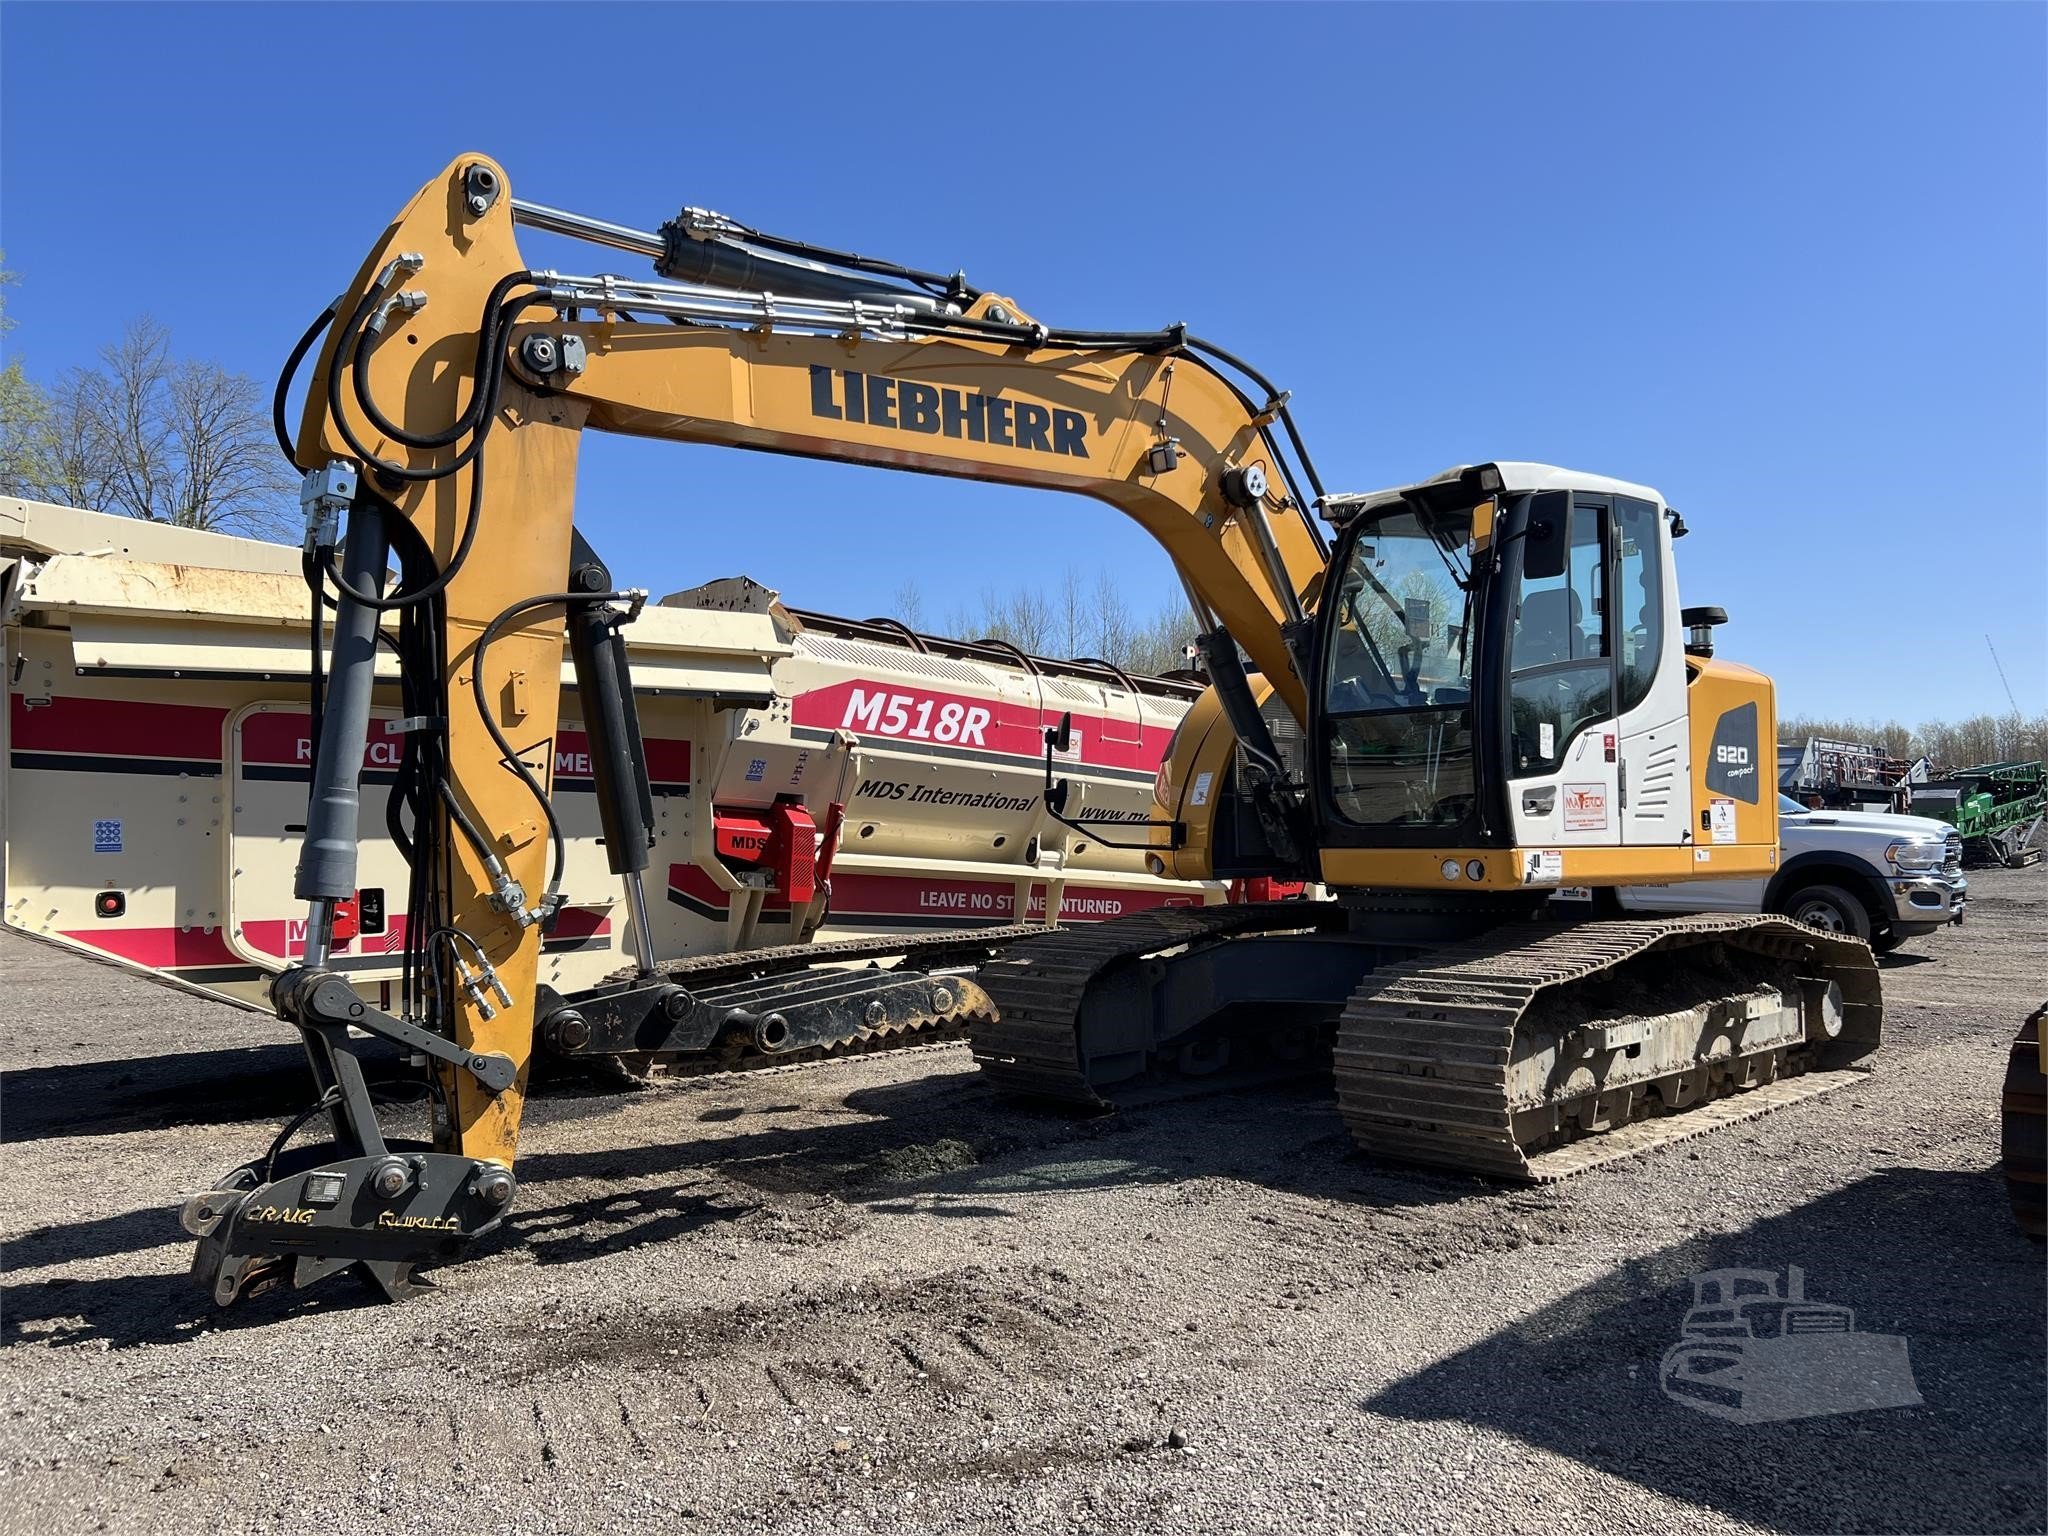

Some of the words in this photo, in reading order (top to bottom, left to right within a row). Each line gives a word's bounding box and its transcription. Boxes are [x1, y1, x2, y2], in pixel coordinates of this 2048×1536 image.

[810, 364, 1090, 459] LIEBHERR
[841, 688, 990, 746] M518R
[1716, 744, 1749, 765] 920
[1727, 763, 1754, 779] compact
[855, 780, 908, 800] MDS
[908, 784, 1039, 812] International
[731, 835, 768, 850] MDS
[920, 891, 966, 908] LEAVE
[971, 894, 992, 909] NO
[996, 895, 1047, 913] STNE
[1060, 898, 1122, 914] NTURNED
[247, 1205, 317, 1224] CRAIG
